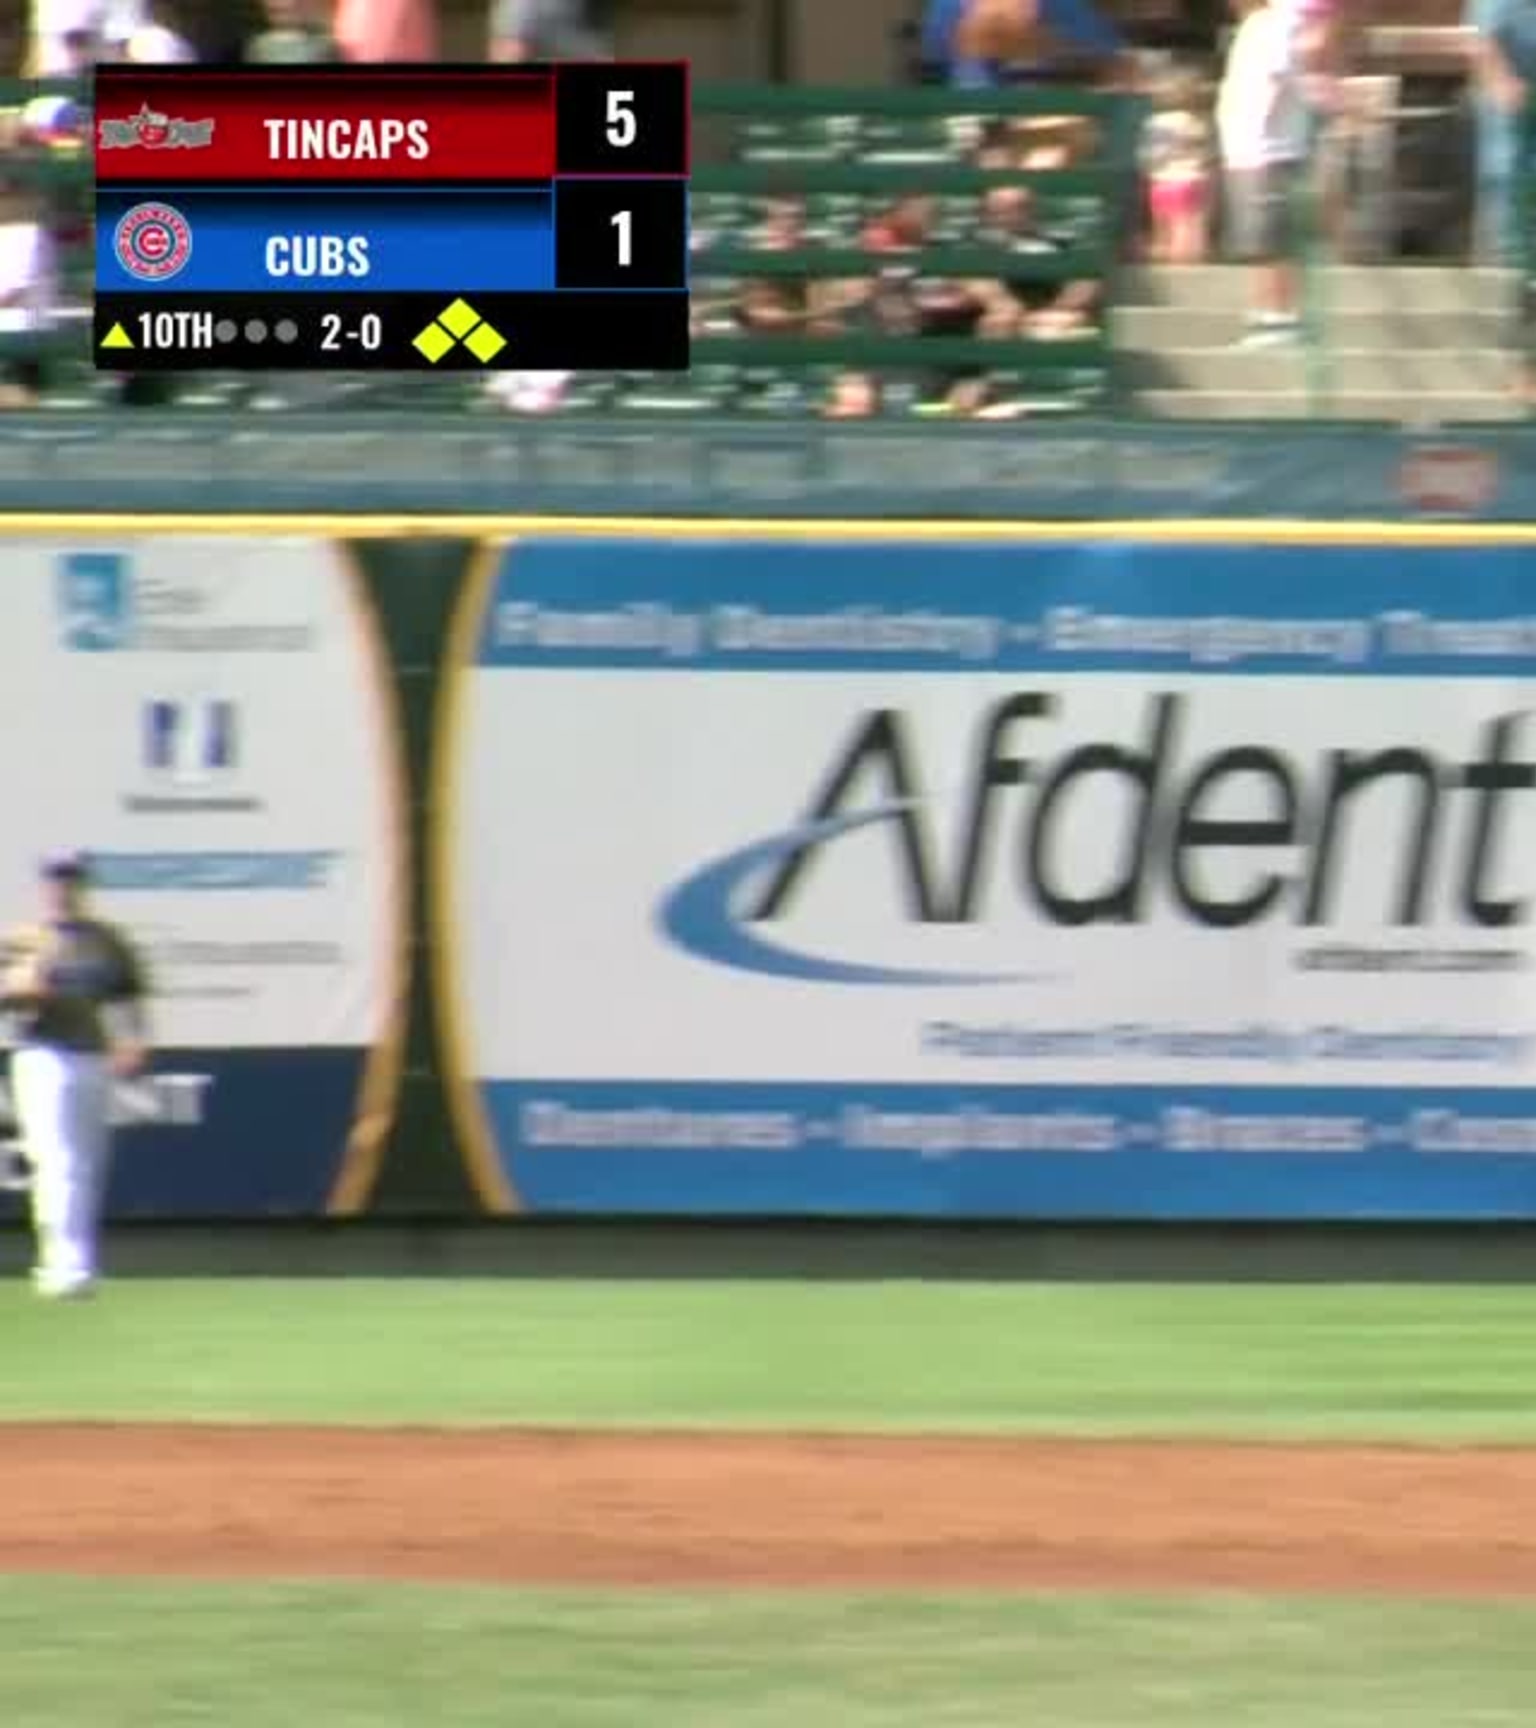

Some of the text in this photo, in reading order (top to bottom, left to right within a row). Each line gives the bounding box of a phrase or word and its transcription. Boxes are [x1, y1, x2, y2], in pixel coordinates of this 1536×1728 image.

[500, 602, 697, 655] Family
[712, 604, 988, 658] Dentistry
[1046, 606, 1370, 663] Emergency
[522, 1102, 797, 1148] Dentures
[842, 1104, 1120, 1156] Implants
[1161, 1106, 1368, 1152] Braces
